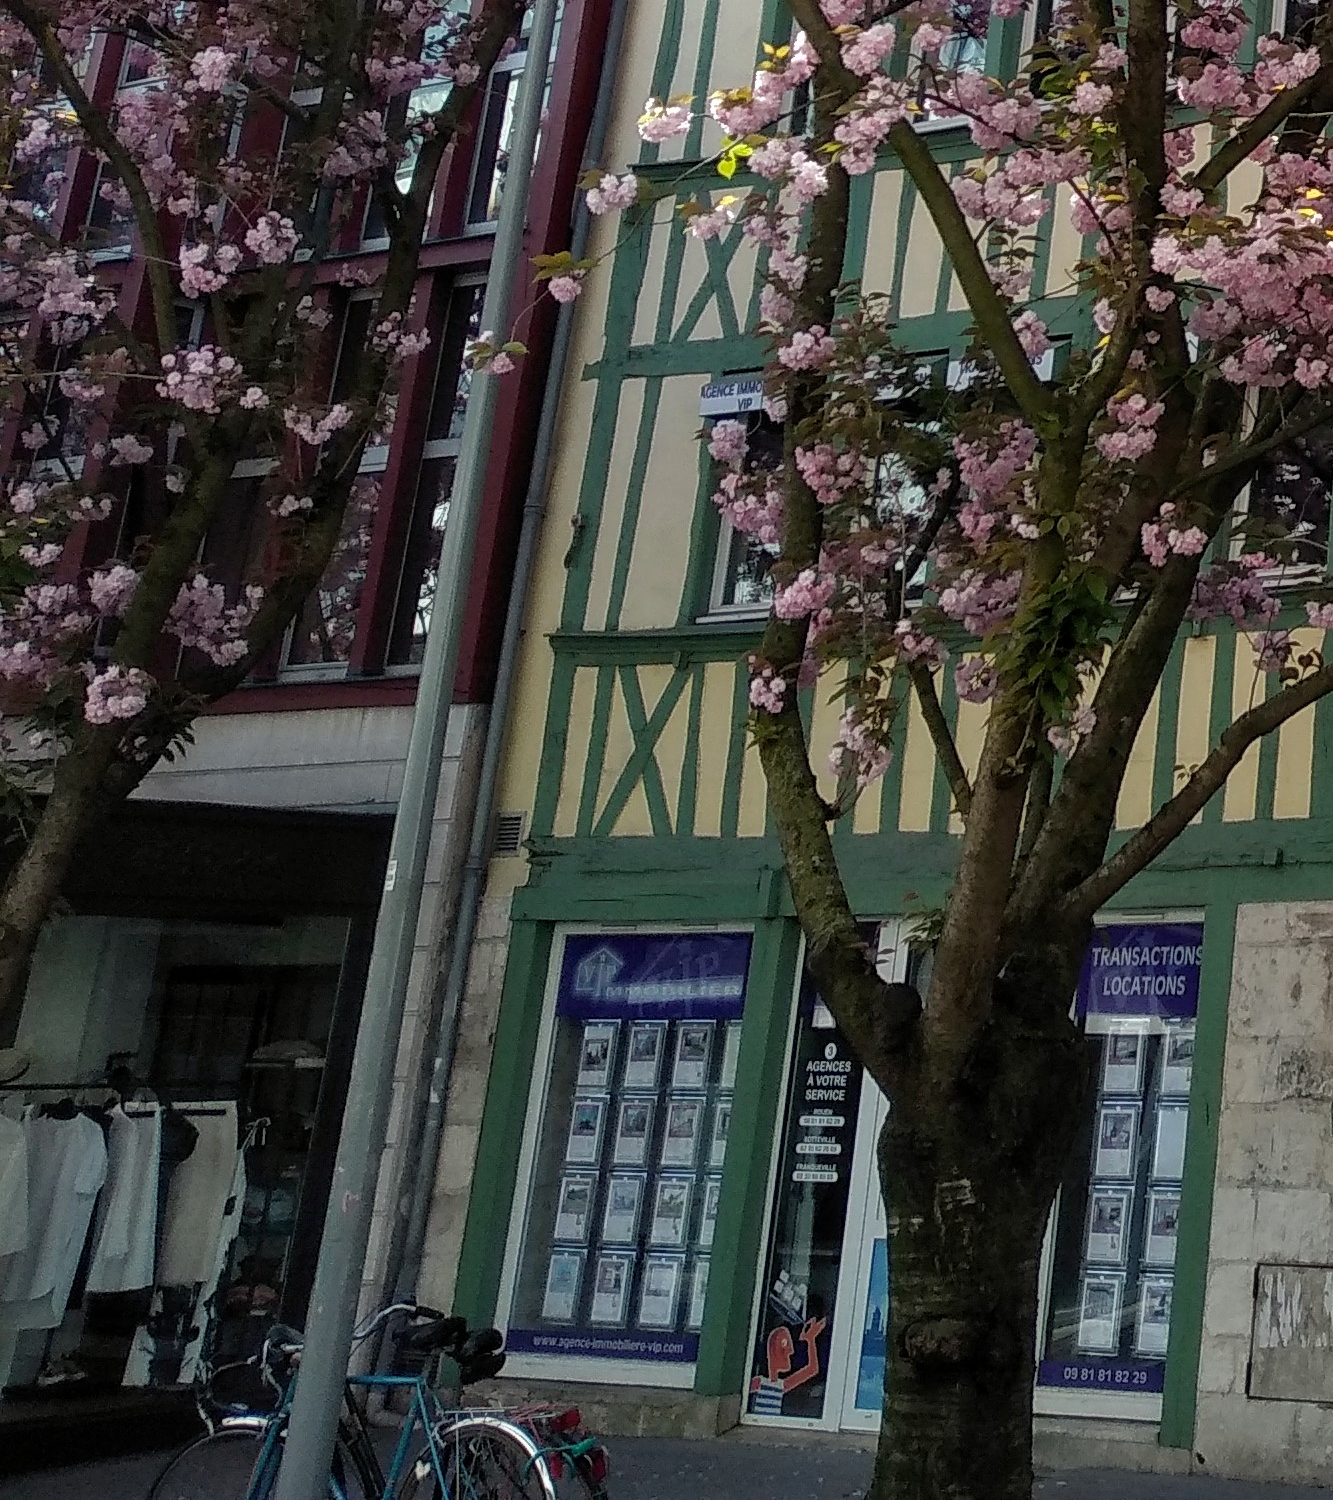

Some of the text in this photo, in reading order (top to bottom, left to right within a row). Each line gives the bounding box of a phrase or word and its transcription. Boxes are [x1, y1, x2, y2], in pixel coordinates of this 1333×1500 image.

[701, 380, 764, 399] AGENCE IMMO
[1092, 945, 1203, 967] TRANSACTIONS
[1102, 975, 1186, 996] LOCATIONS
[826, 1045, 836, 1058] 3
[806, 1060, 852, 1073] AGENCES
[806, 1072, 848, 1087] À VOTRE
[805, 1088, 846, 1101] SERVICE
[1063, 1367, 1148, 1384] 09 81 81 82 29
